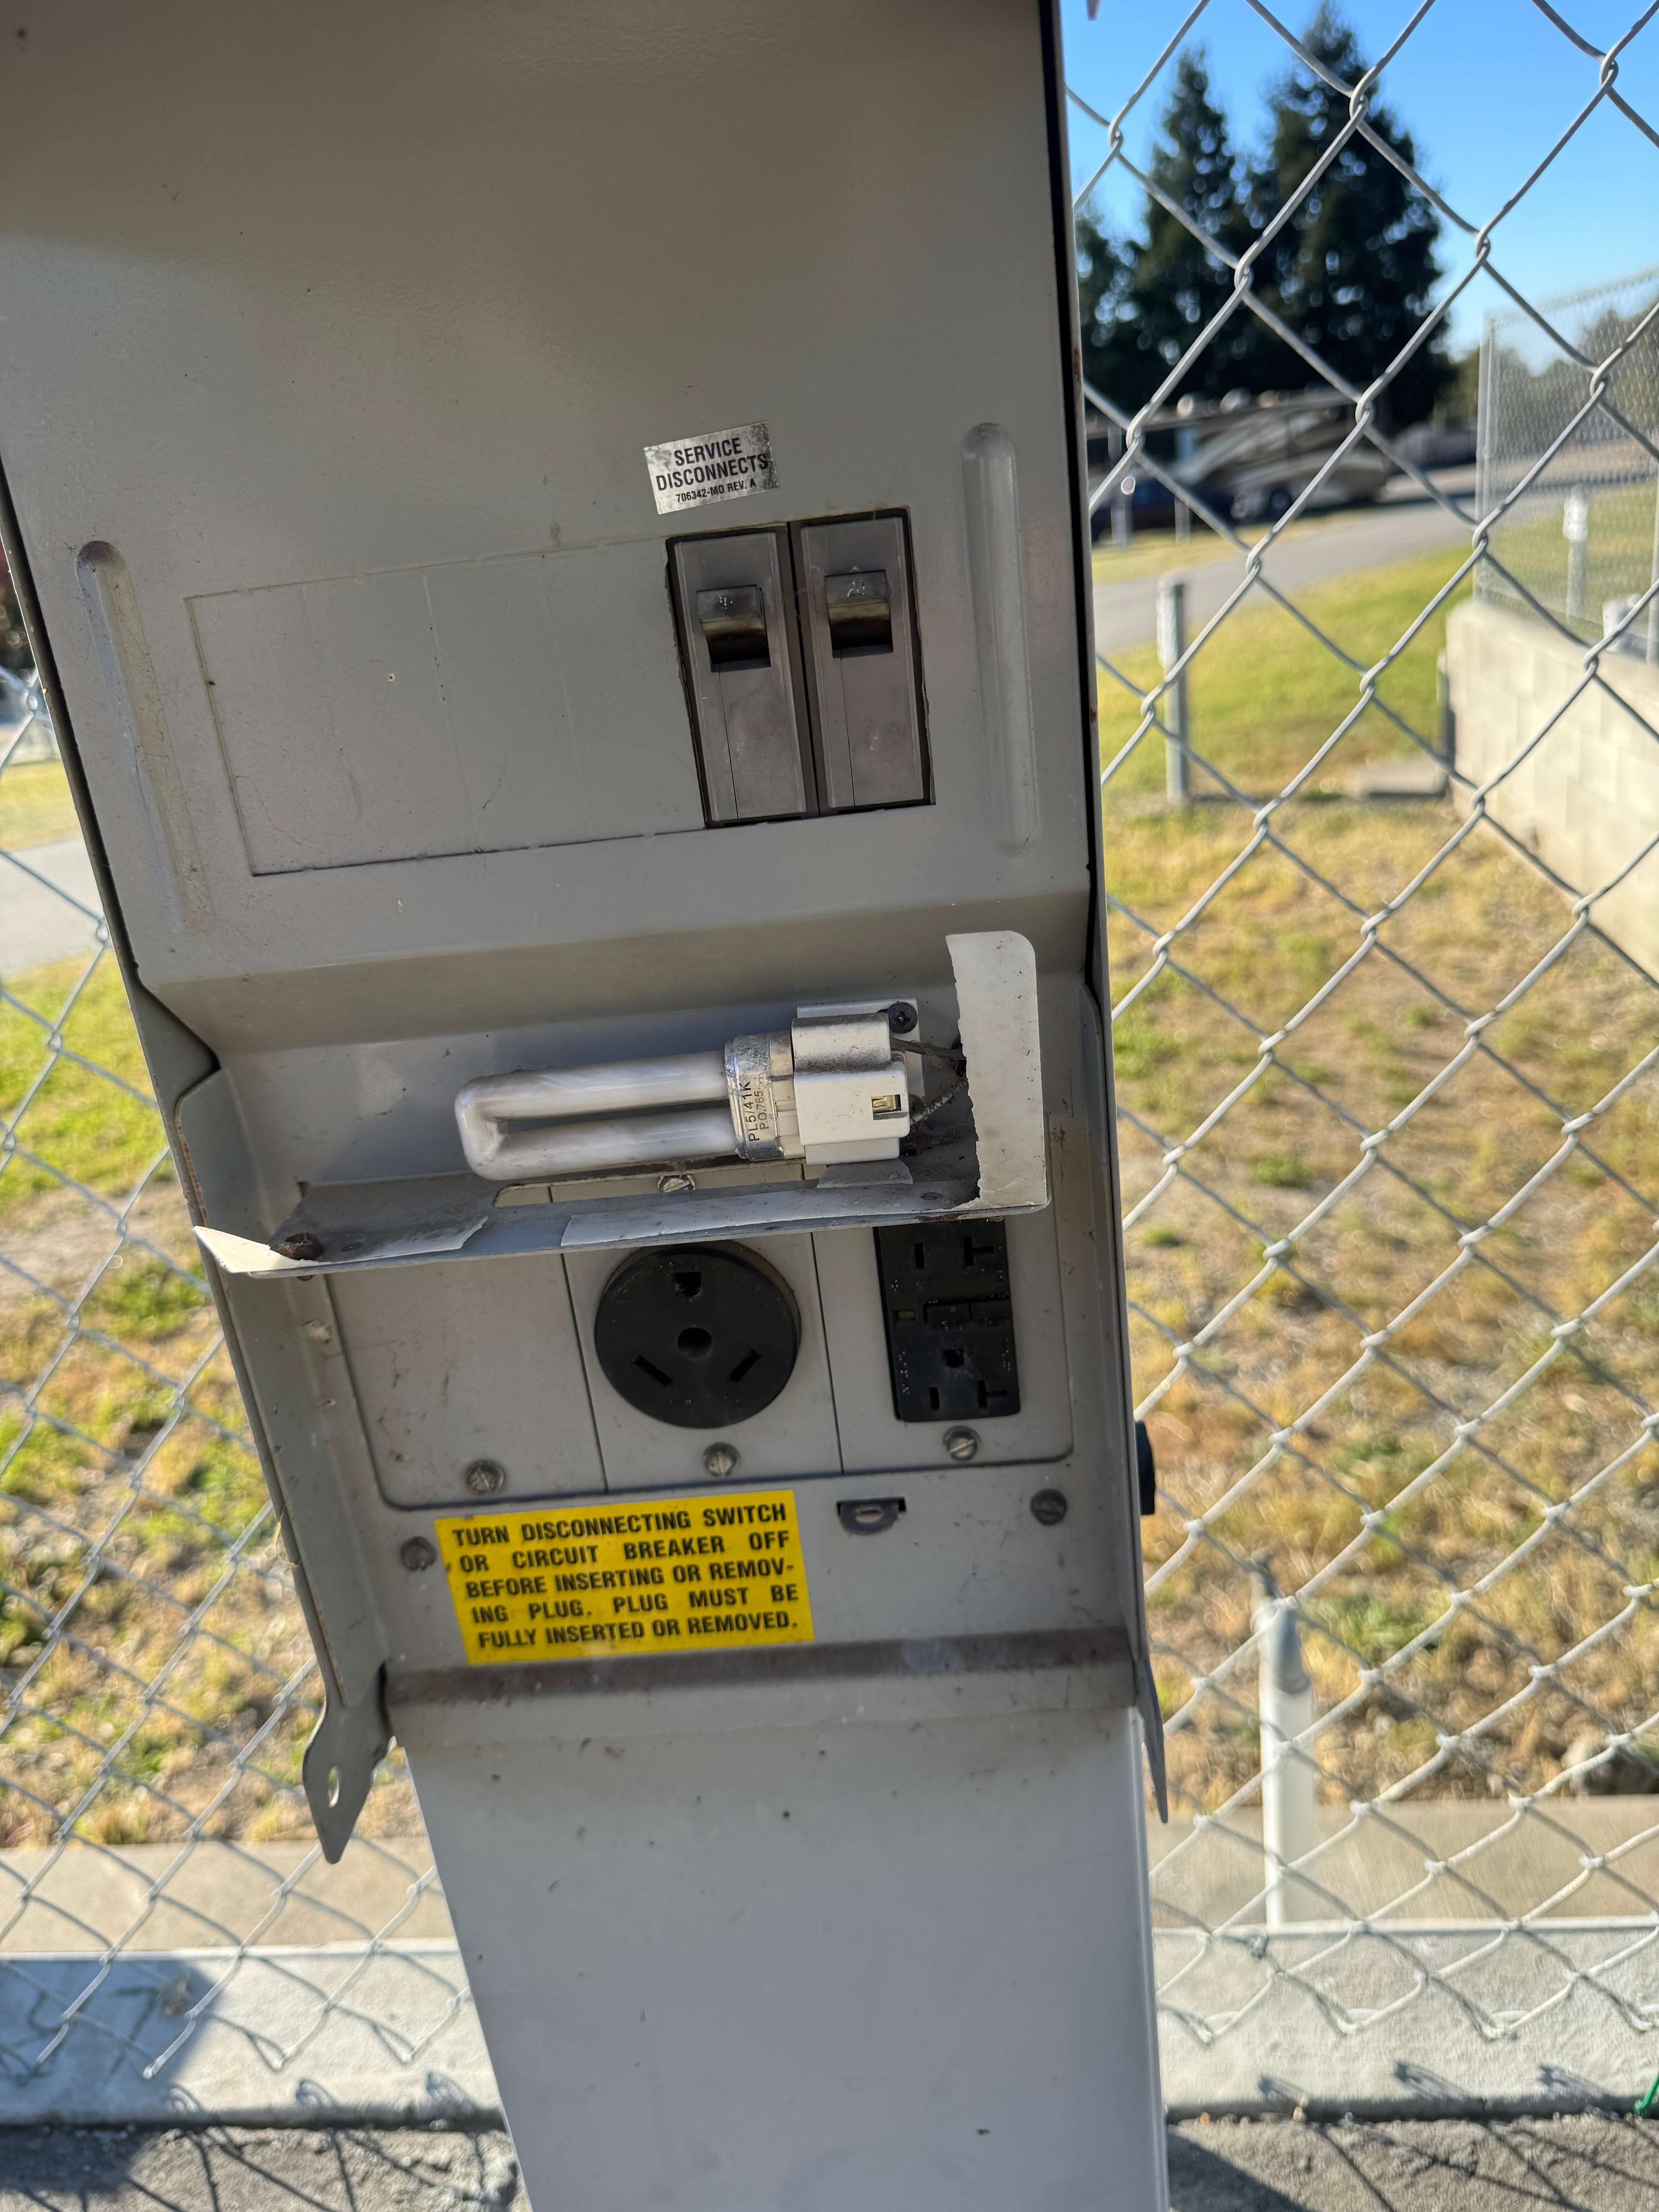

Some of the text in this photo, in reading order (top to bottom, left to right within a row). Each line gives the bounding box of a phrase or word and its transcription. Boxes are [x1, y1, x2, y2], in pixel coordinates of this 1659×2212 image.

[674, 437, 742, 466] SERVICE
[656, 454, 768, 491] DISCONNECTS
[728, 481, 747, 493] REV.
[750, 478, 756, 488] A
[739, 1081, 760, 1141] PL5/41K
[452, 1503, 787, 1547] TURN DISCONNECTING SWITCH
[460, 1530, 790, 1573] OR CIRCUIT BREAKER OFF
[466, 1558, 794, 1599] BEFORE INSERTING OR REMOV-
[472, 1584, 798, 1623] ING PLUG. PLUG MUST BE
[478, 1611, 798, 1648] FULLY INSERTED OR REMOVED.
